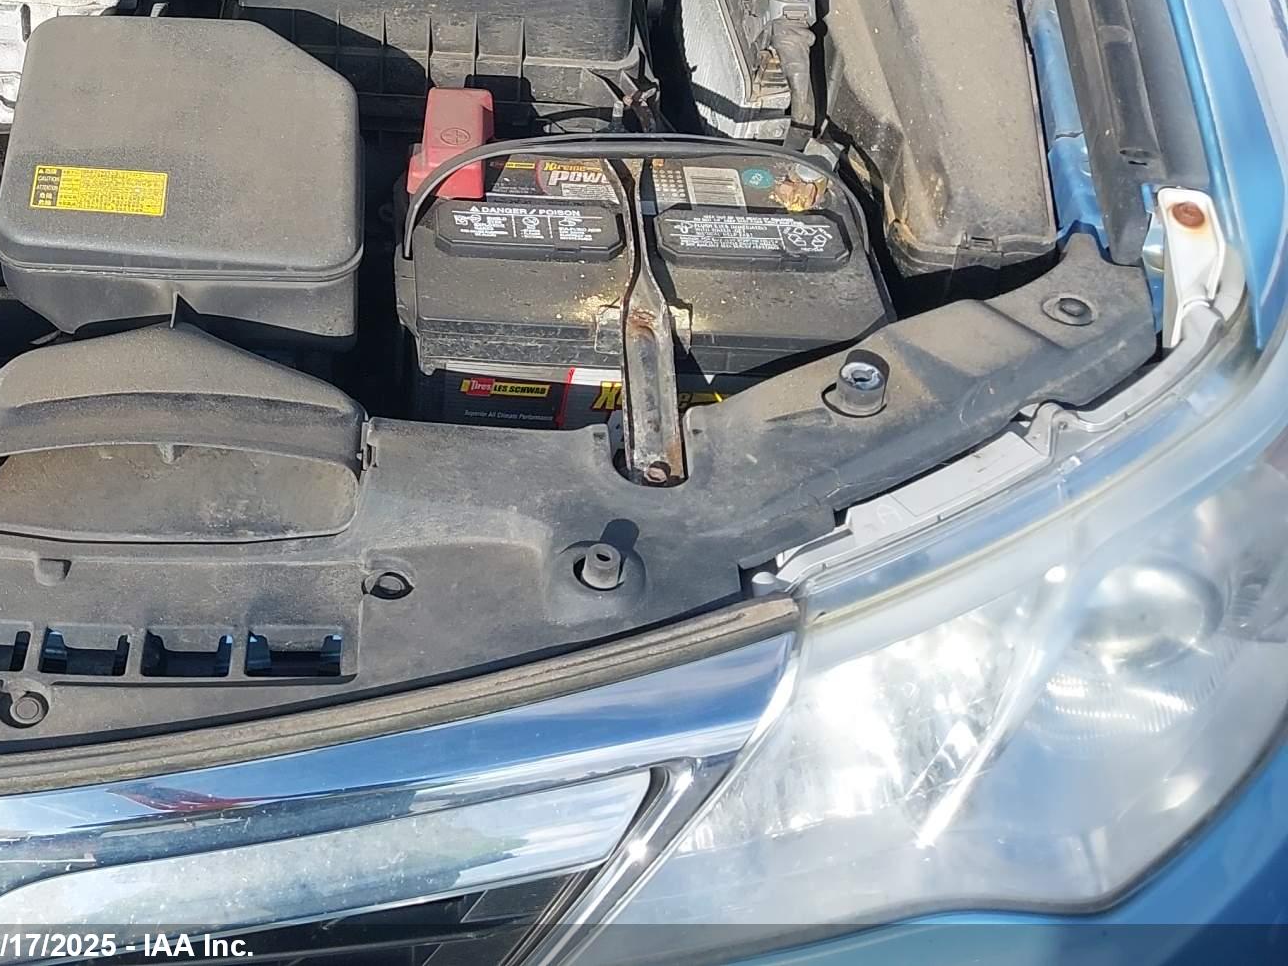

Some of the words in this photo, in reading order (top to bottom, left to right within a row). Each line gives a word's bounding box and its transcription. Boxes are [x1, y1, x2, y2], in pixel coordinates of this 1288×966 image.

[481, 206, 527, 215] DANGER
[538, 209, 581, 217] POISON
[470, 379, 492, 391] Tires
[494, 384, 508, 392] LES
[509, 385, 547, 395] SCHWAB
